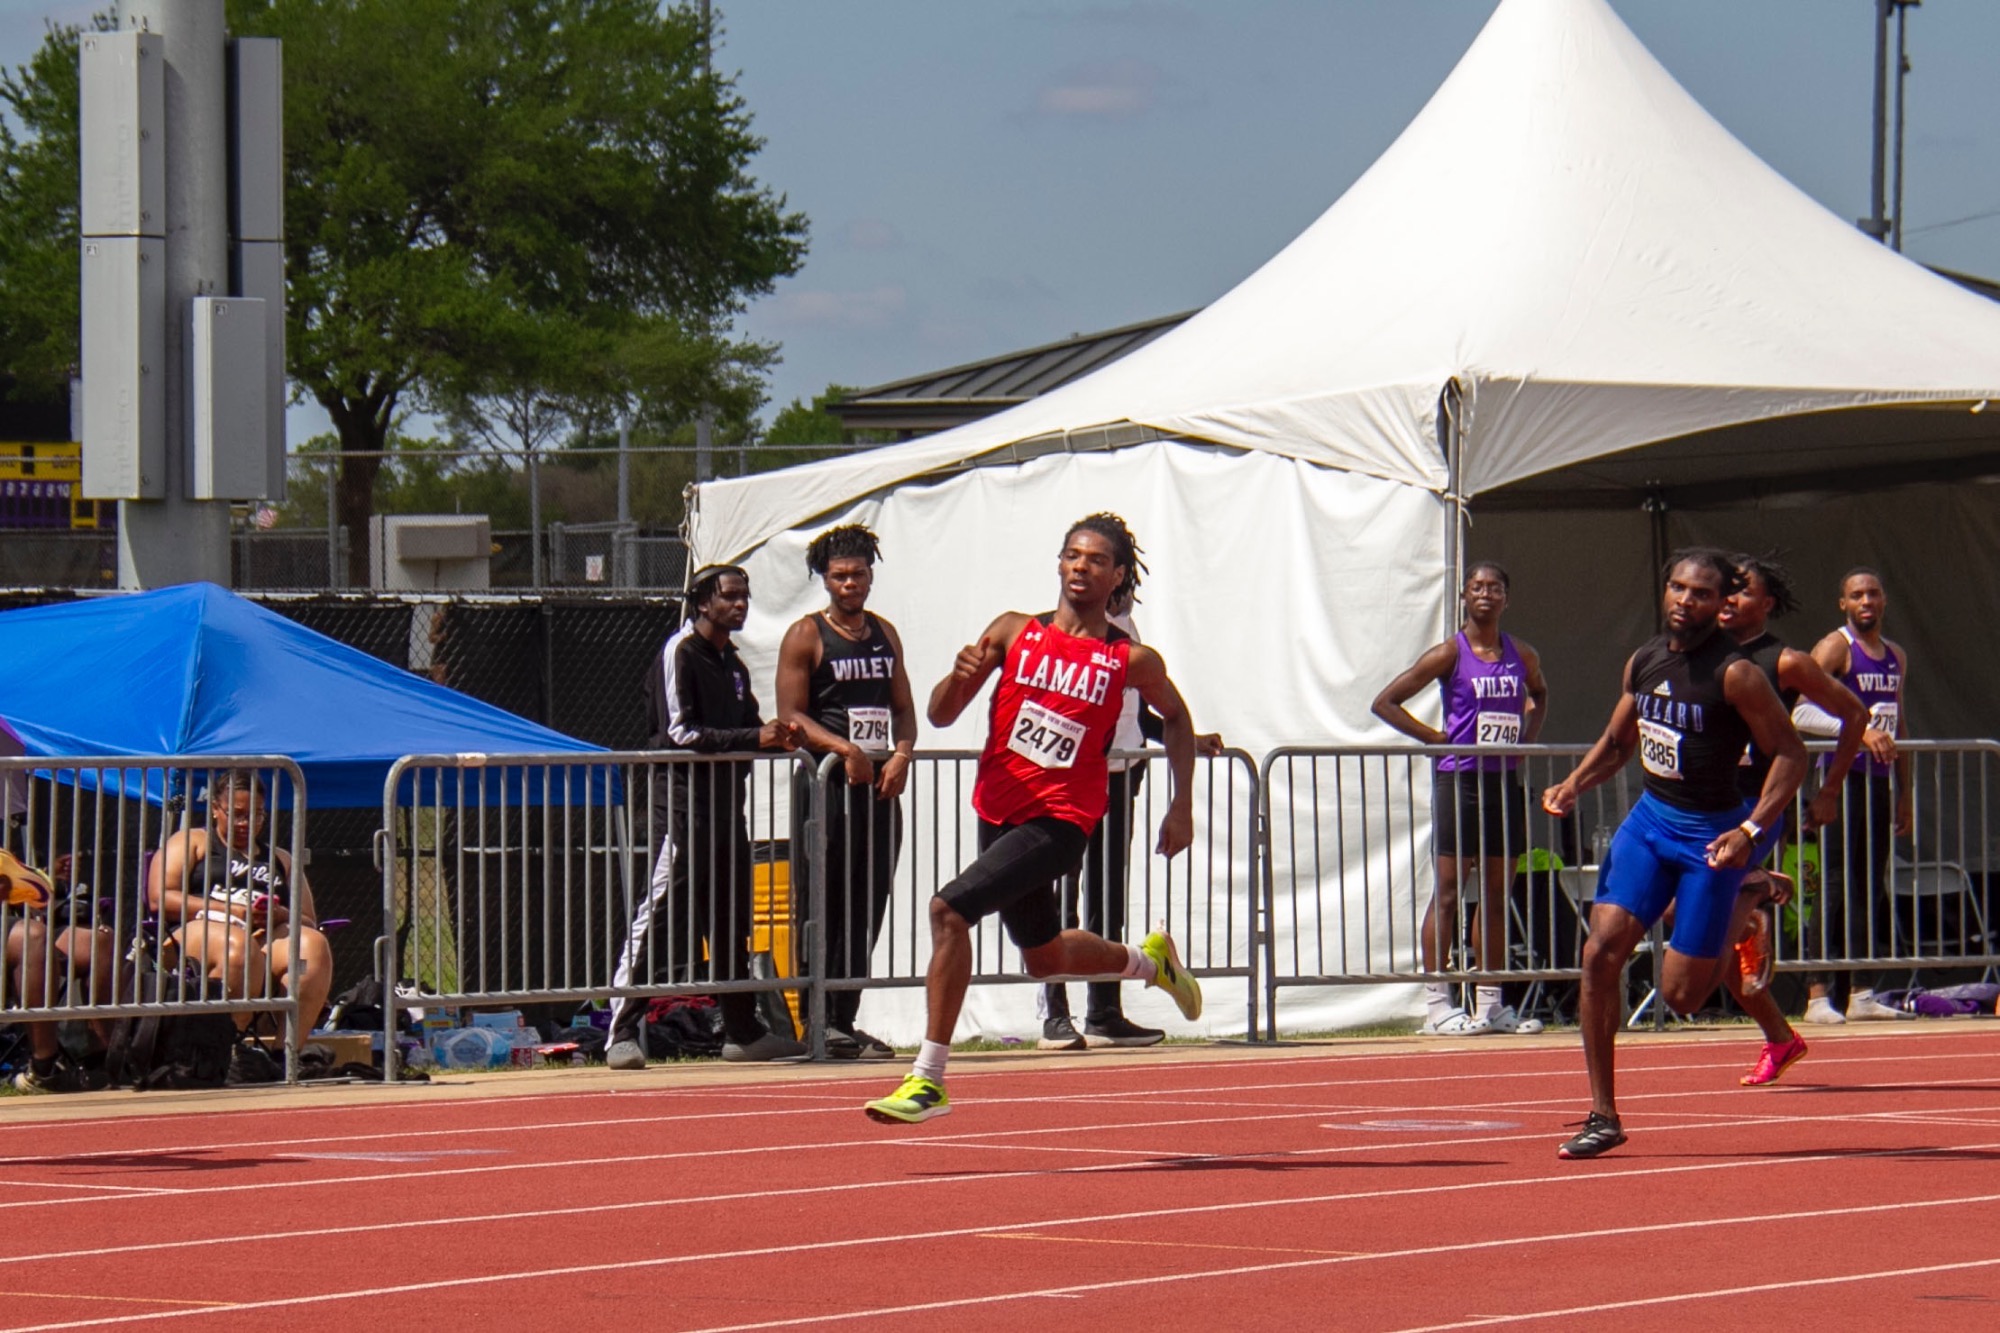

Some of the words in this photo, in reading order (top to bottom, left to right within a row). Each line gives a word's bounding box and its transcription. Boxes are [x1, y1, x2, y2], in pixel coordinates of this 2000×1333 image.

[830, 656, 893, 681] WILEY
[1015, 650, 1110, 705] LAMAR
[1471, 676, 1518, 698] WILEY
[1635, 692, 1704, 732] ILLARD
[853, 720, 888, 740] 2764
[1015, 717, 1075, 761] 2479
[1481, 724, 1518, 744] 2746
[1641, 734, 1676, 770] 2385
